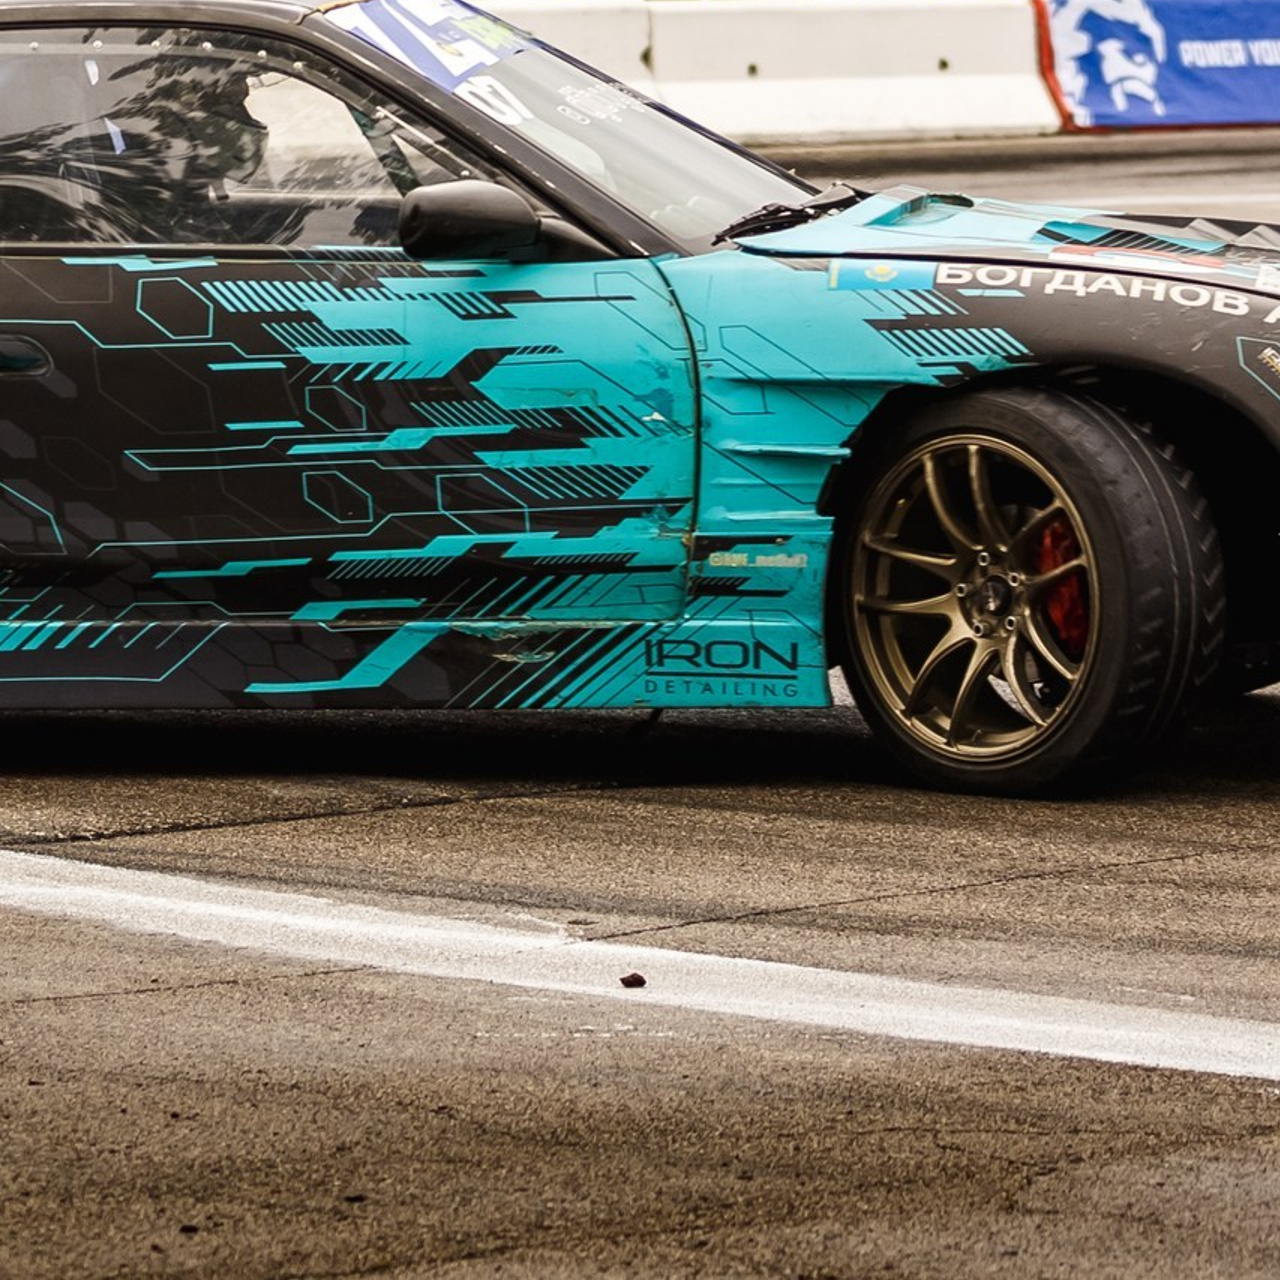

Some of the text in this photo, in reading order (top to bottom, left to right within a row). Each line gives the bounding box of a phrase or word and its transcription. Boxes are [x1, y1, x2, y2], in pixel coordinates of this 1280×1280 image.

[1179, 39, 1246, 68] POWER
[935, 262, 1250, 317] БОГДАНОВ
[644, 638, 799, 670] IRON
[644, 678, 799, 698] DETAILING
